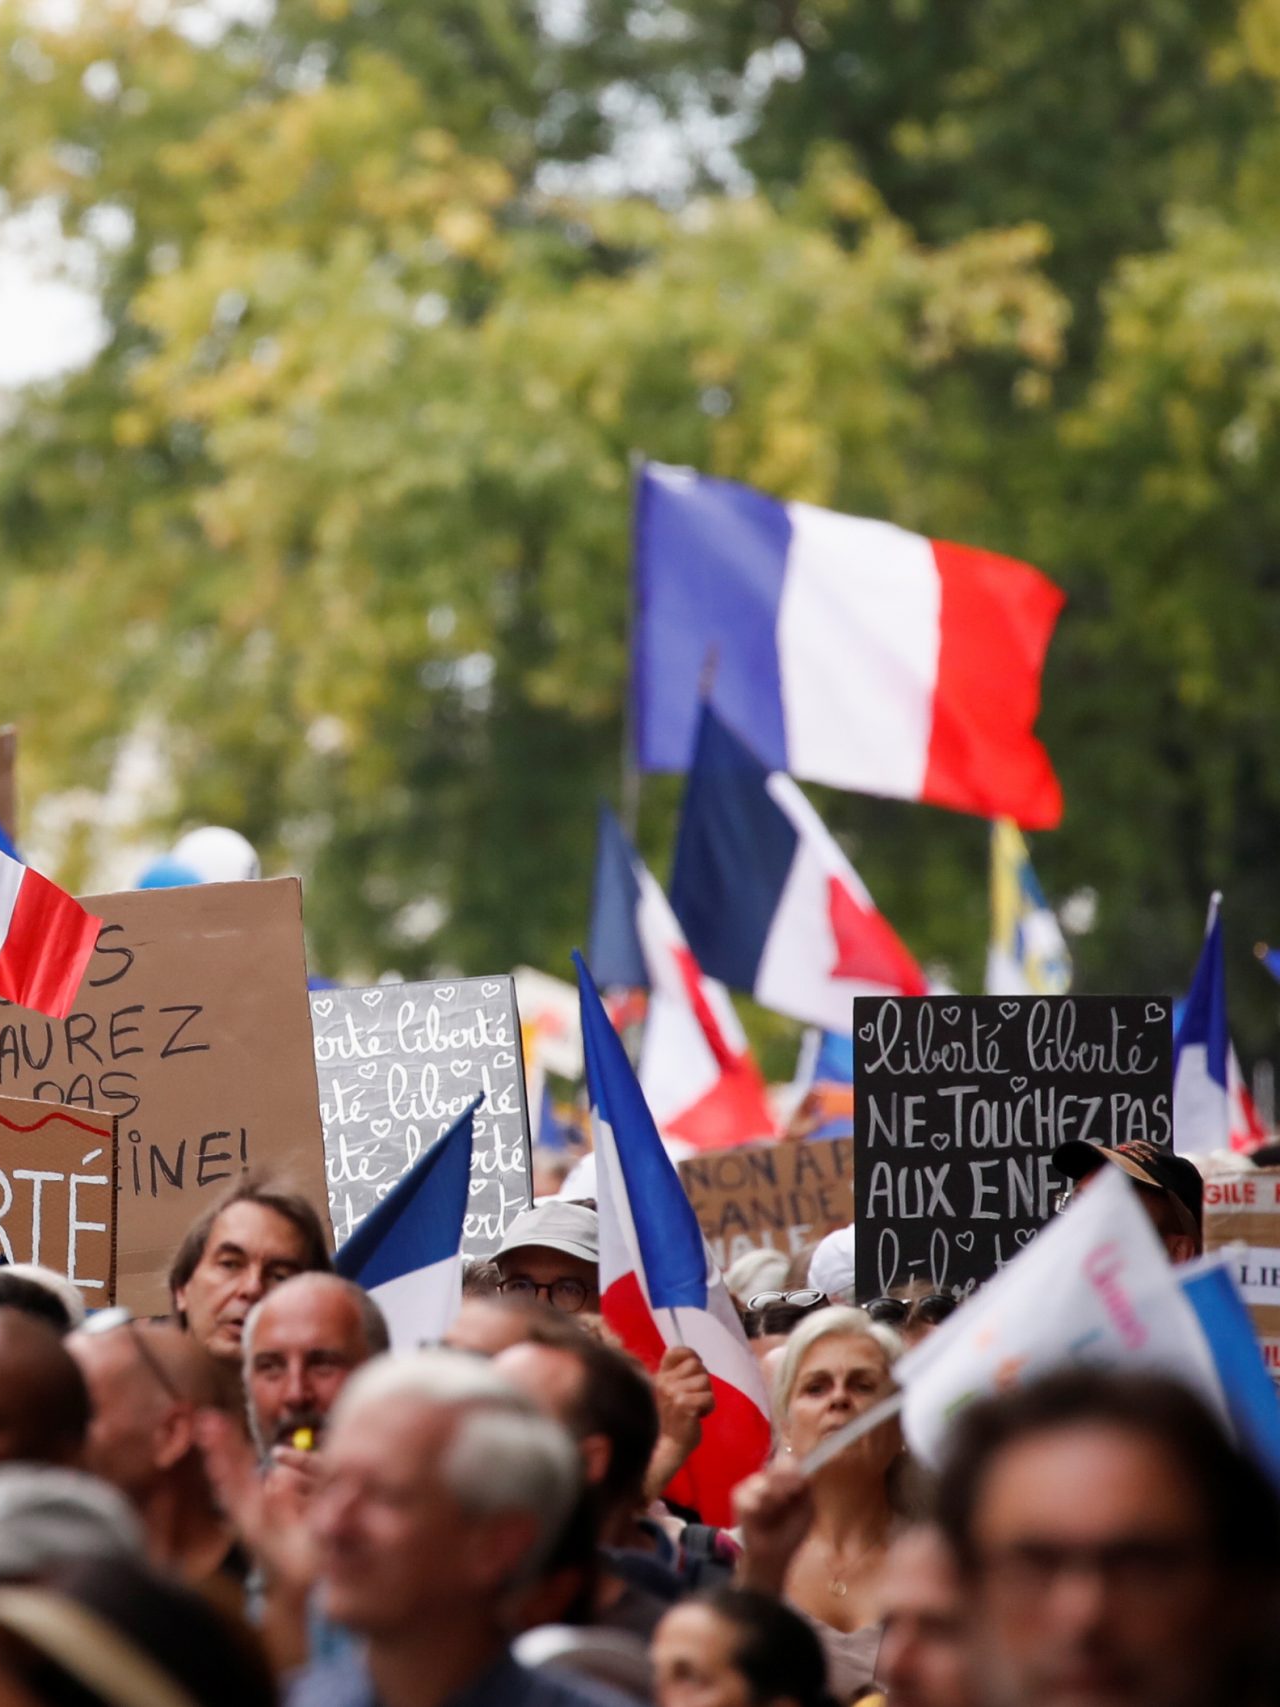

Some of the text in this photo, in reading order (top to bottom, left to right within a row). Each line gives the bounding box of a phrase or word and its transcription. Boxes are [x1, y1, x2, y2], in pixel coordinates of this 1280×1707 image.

[397, 1000, 516, 1054] liberté
[865, 999, 1158, 1075] liberté liberté
[867, 1085, 1173, 1148] NE TOUCHEZ PAS
[866, 1162, 958, 1219] AUX
